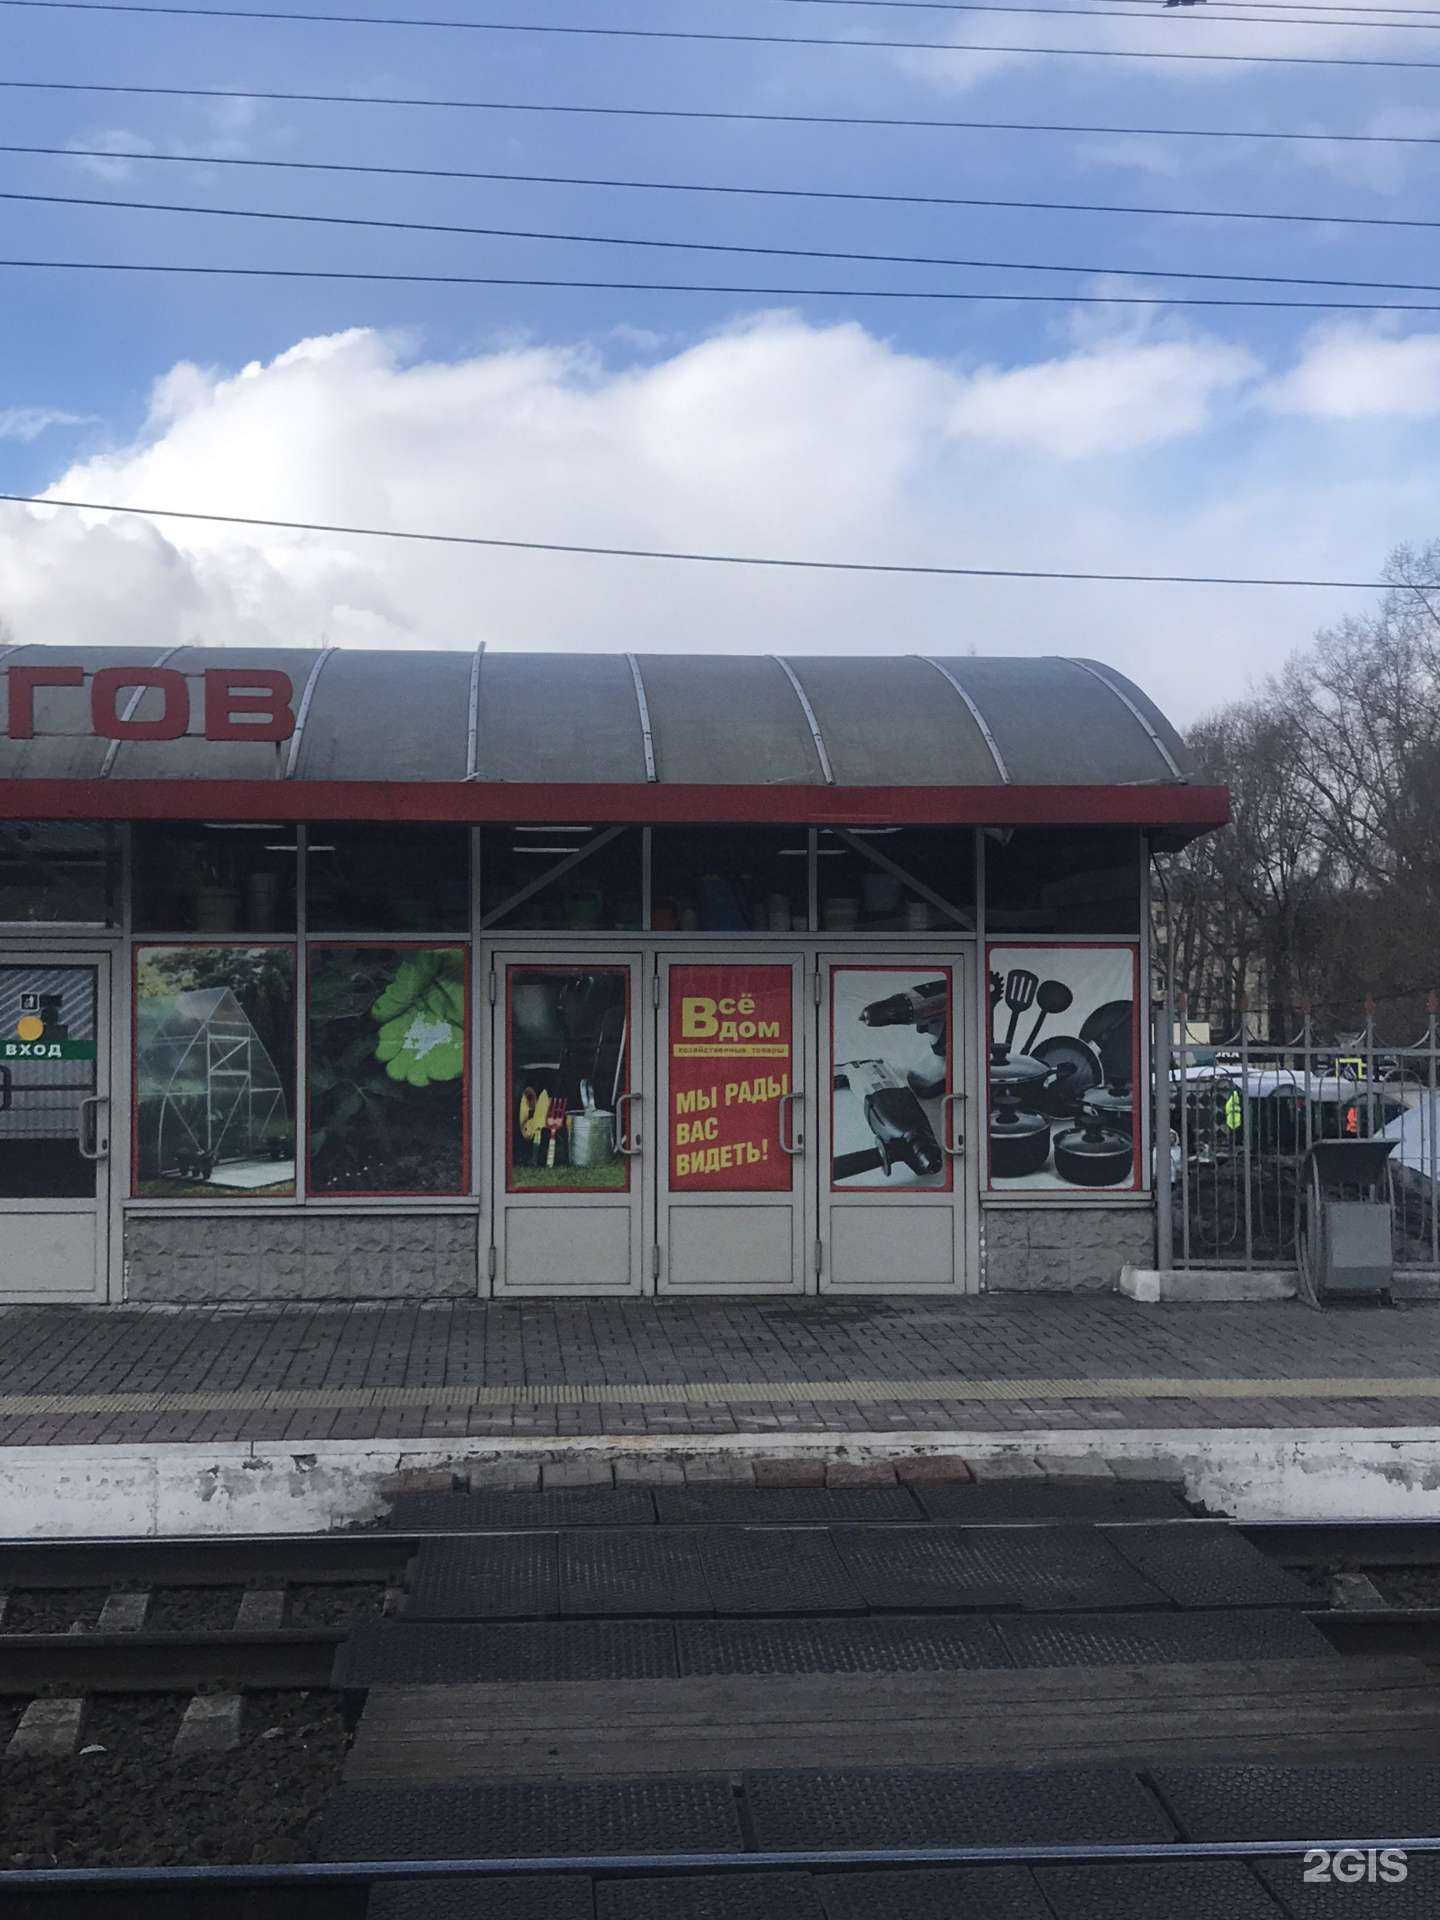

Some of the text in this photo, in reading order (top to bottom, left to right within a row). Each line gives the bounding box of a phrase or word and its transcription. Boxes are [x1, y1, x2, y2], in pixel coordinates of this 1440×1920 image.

[5, 1043, 62, 1058] ВХОД
[675, 1073, 789, 1115] МЫ РАДЫ
[675, 1116, 719, 1146] ВАС
[675, 1138, 769, 1177] ВИДЕТЬ!
